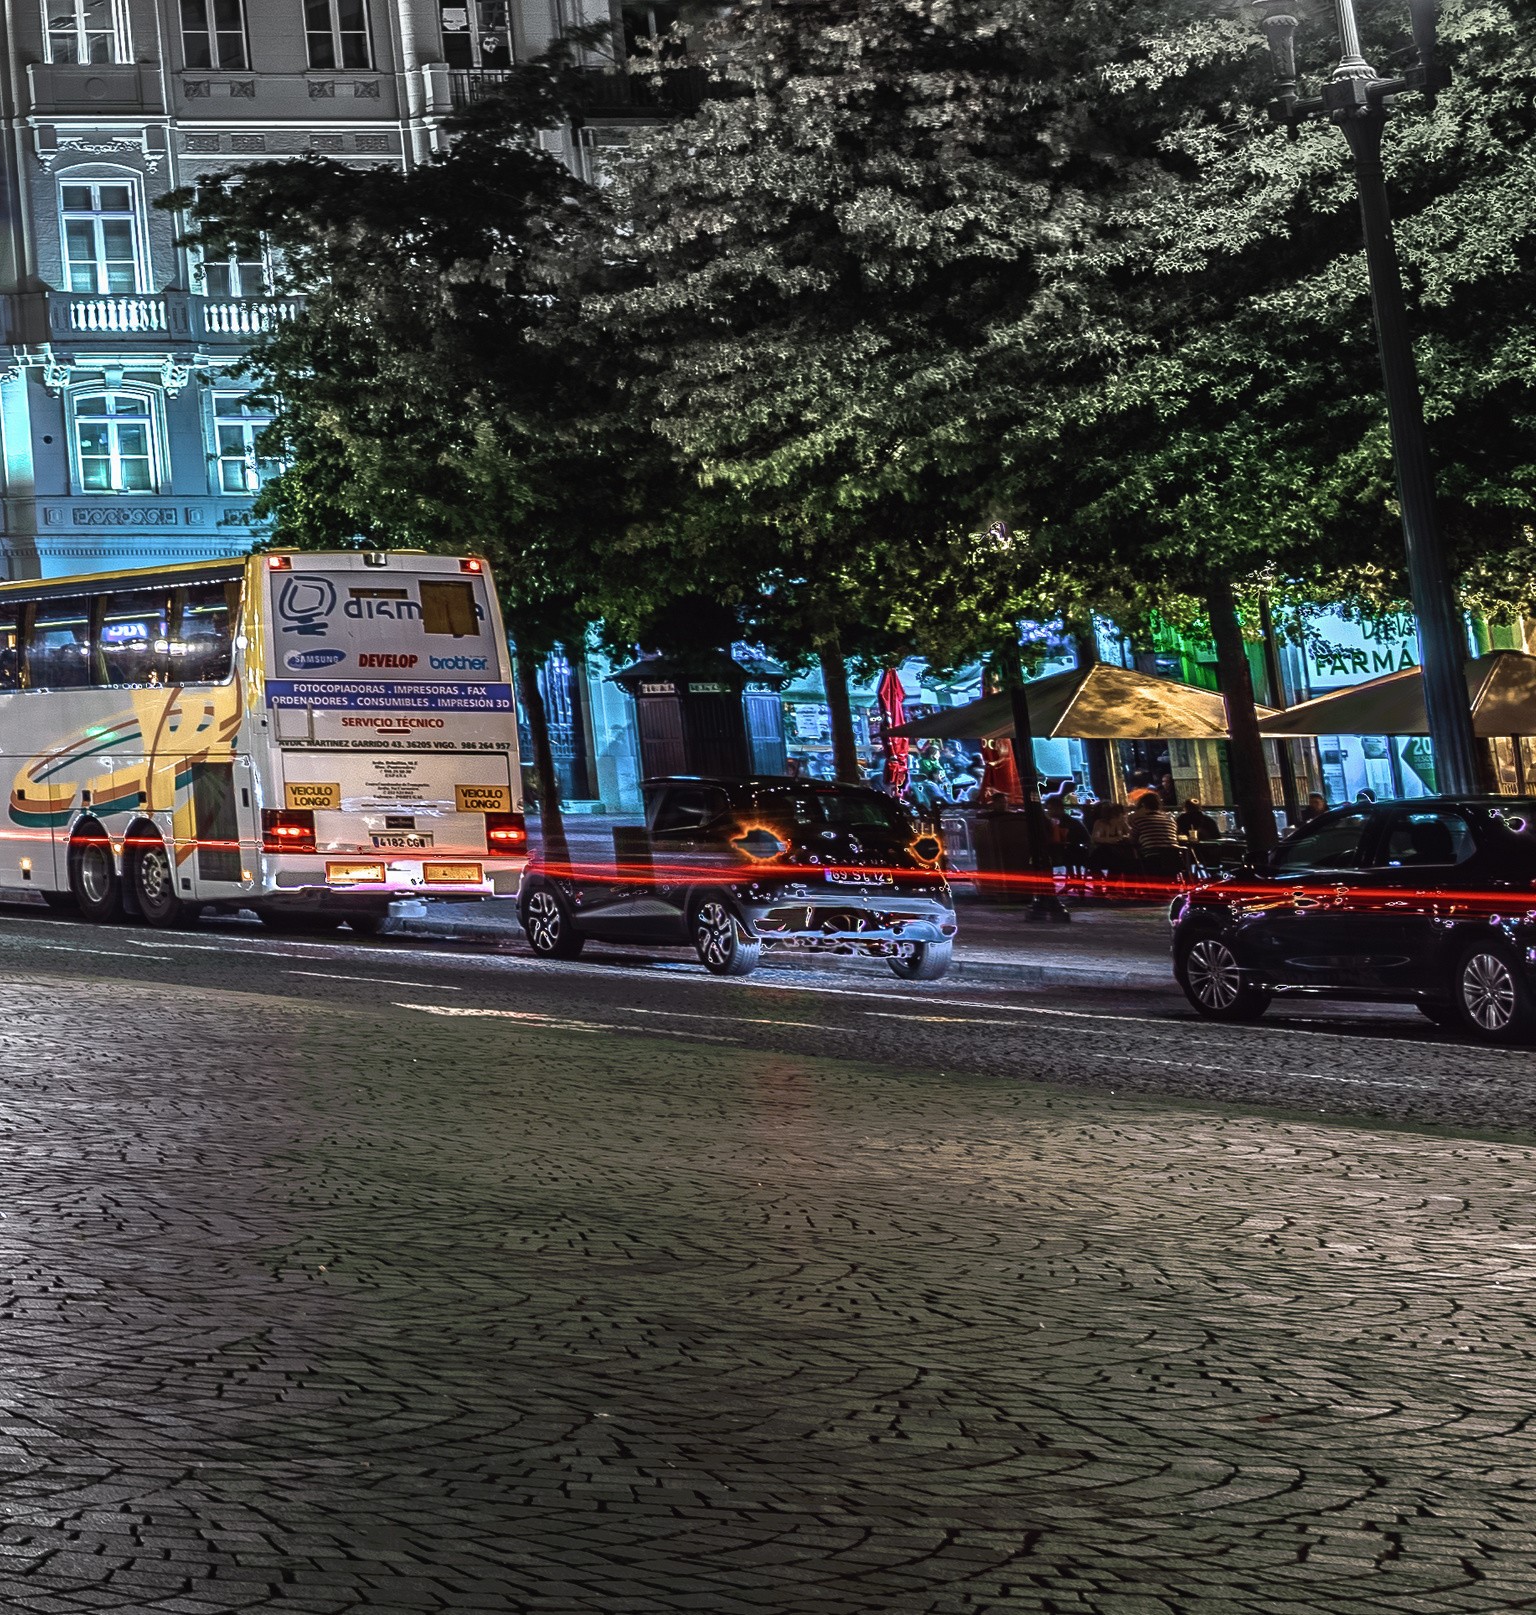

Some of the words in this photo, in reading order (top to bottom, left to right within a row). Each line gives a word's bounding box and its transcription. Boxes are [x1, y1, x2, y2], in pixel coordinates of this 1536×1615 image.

[294, 654, 340, 664] SAMSUNG
[358, 653, 418, 669] DEVELOP
[428, 655, 489, 671] brother
[293, 683, 385, 694] FOTOCOPIADORAS
[393, 685, 459, 695] IMPRESORAS
[467, 686, 487, 696] FAX
[271, 695, 348, 706] ORDENADORES
[356, 697, 429, 707] CONSUMIBLES
[437, 697, 493, 708] IMPRESIÓN
[496, 699, 510, 708] 3D
[341, 717, 392, 727] SERVICIO
[395, 716, 444, 728] TÉCNICO
[306, 739, 349, 748] MARTINEZ
[351, 740, 390, 748] GARRIDO
[406, 741, 432, 749] 36205
[433, 741, 457, 749] VIGO.
[478, 742, 494, 750] 264
[495, 742, 511, 750] 957
[290, 786, 333, 797] VEICULO
[460, 788, 503, 799] VEICULO
[294, 796, 330, 807] LONGO
[464, 798, 501, 809] LONGO
[379, 838, 405, 847] 4182
